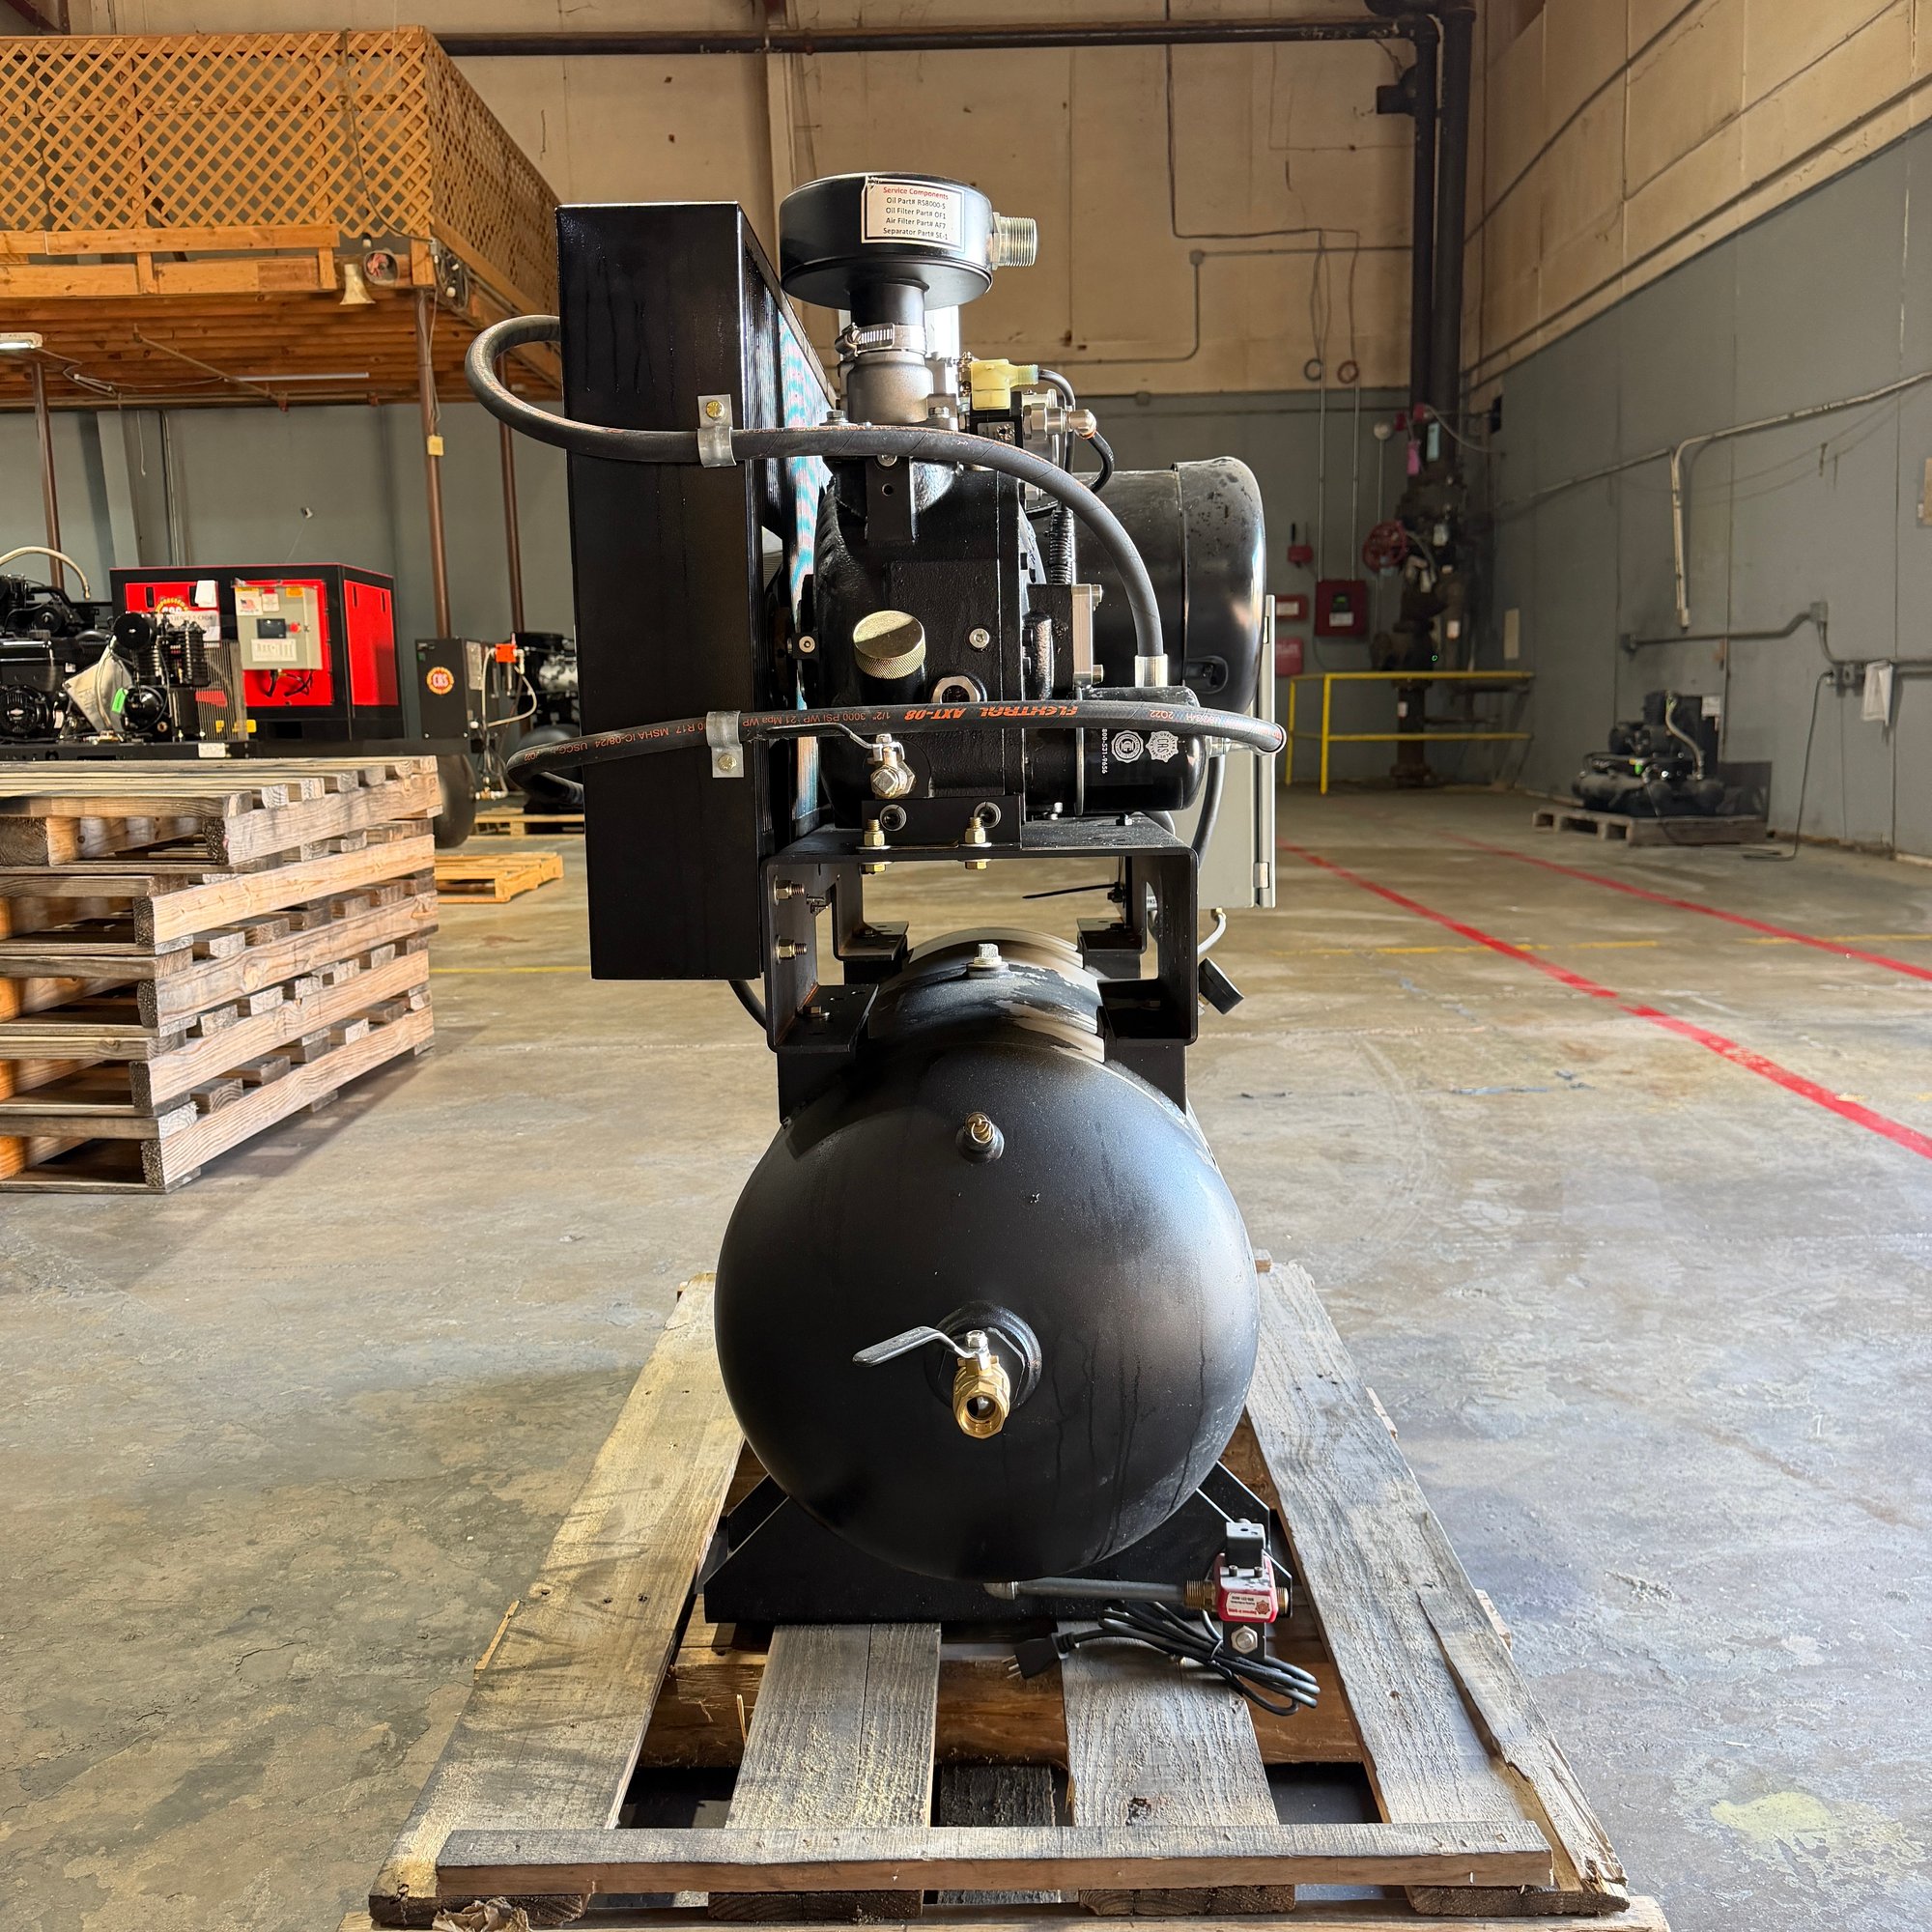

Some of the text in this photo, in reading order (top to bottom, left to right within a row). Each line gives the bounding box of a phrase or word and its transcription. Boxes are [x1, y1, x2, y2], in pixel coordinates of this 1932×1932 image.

[883, 186, 949, 200] Service Components
[916, 209, 933, 217] Part#
[883, 227, 916, 236] Separator
[918, 229, 934, 238] Part#
[803, 714, 820, 724] WP
[823, 713, 840, 723] PSI
[842, 711, 867, 722] 3000
[872, 711, 891, 721] 1/2"
[904, 707, 966, 721] AXT-08
[742, 717, 759, 727] WP
[762, 715, 782, 725] Mpa
[785, 715, 797, 724] 21
[639, 727, 669, 740] MSHA
[676, 724, 695, 734] R17
[595, 733, 636, 748] IC-08/24
[1157, 738, 1170, 753] CAS
